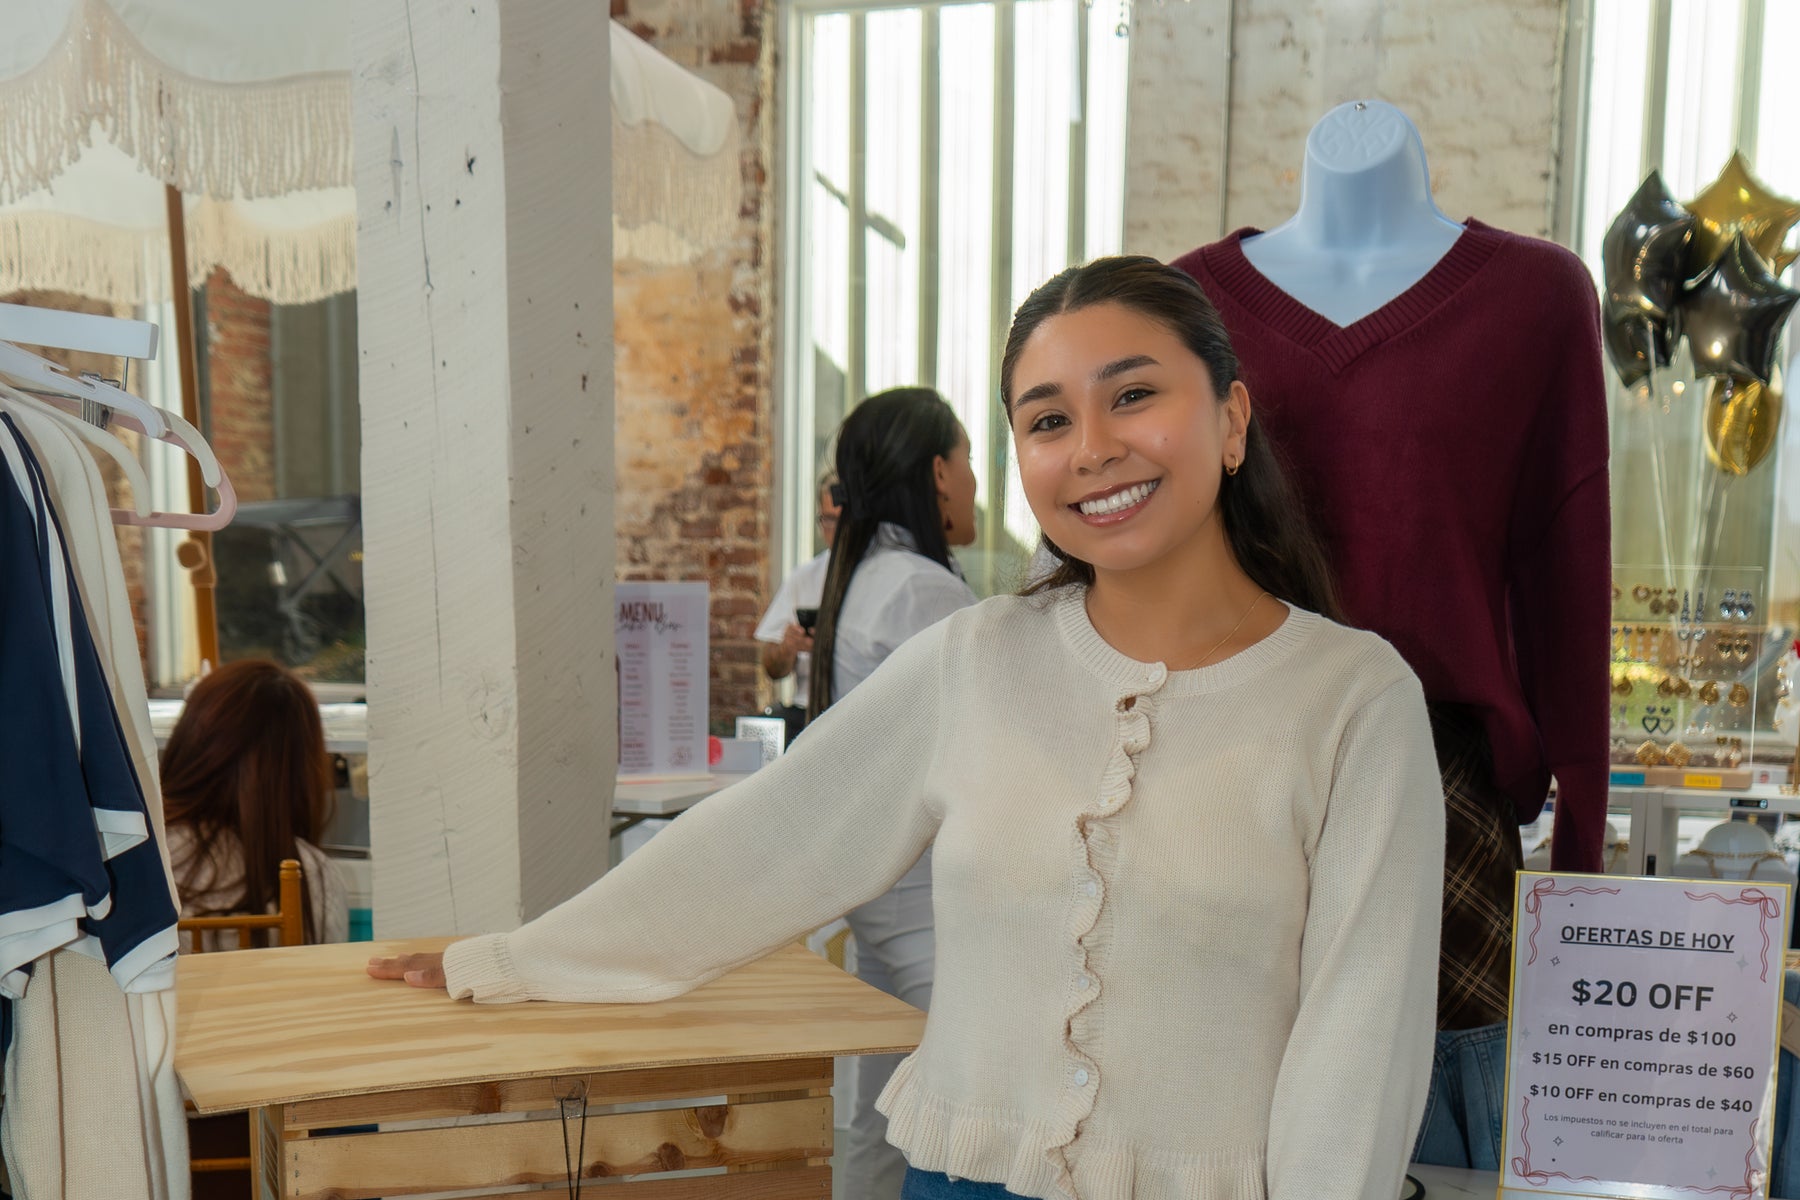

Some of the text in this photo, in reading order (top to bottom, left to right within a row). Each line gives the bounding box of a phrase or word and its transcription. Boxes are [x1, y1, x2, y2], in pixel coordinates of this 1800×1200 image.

[619, 602, 665, 623] MENU
[1561, 925, 1735, 950] OFERTAS DE HOY
[1571, 978, 1714, 1011] $20 OFF
[1548, 1023, 1736, 1047] en compras de $100
[1532, 1052, 1755, 1080] $15 OFF en compras de $60
[1529, 1084, 1753, 1113] $10 OFF en compras de $40
[1543, 1113, 1734, 1137] Los impuestos no se incluyen en el total para
[1590, 1129, 1684, 1145] calificar para la oferta
